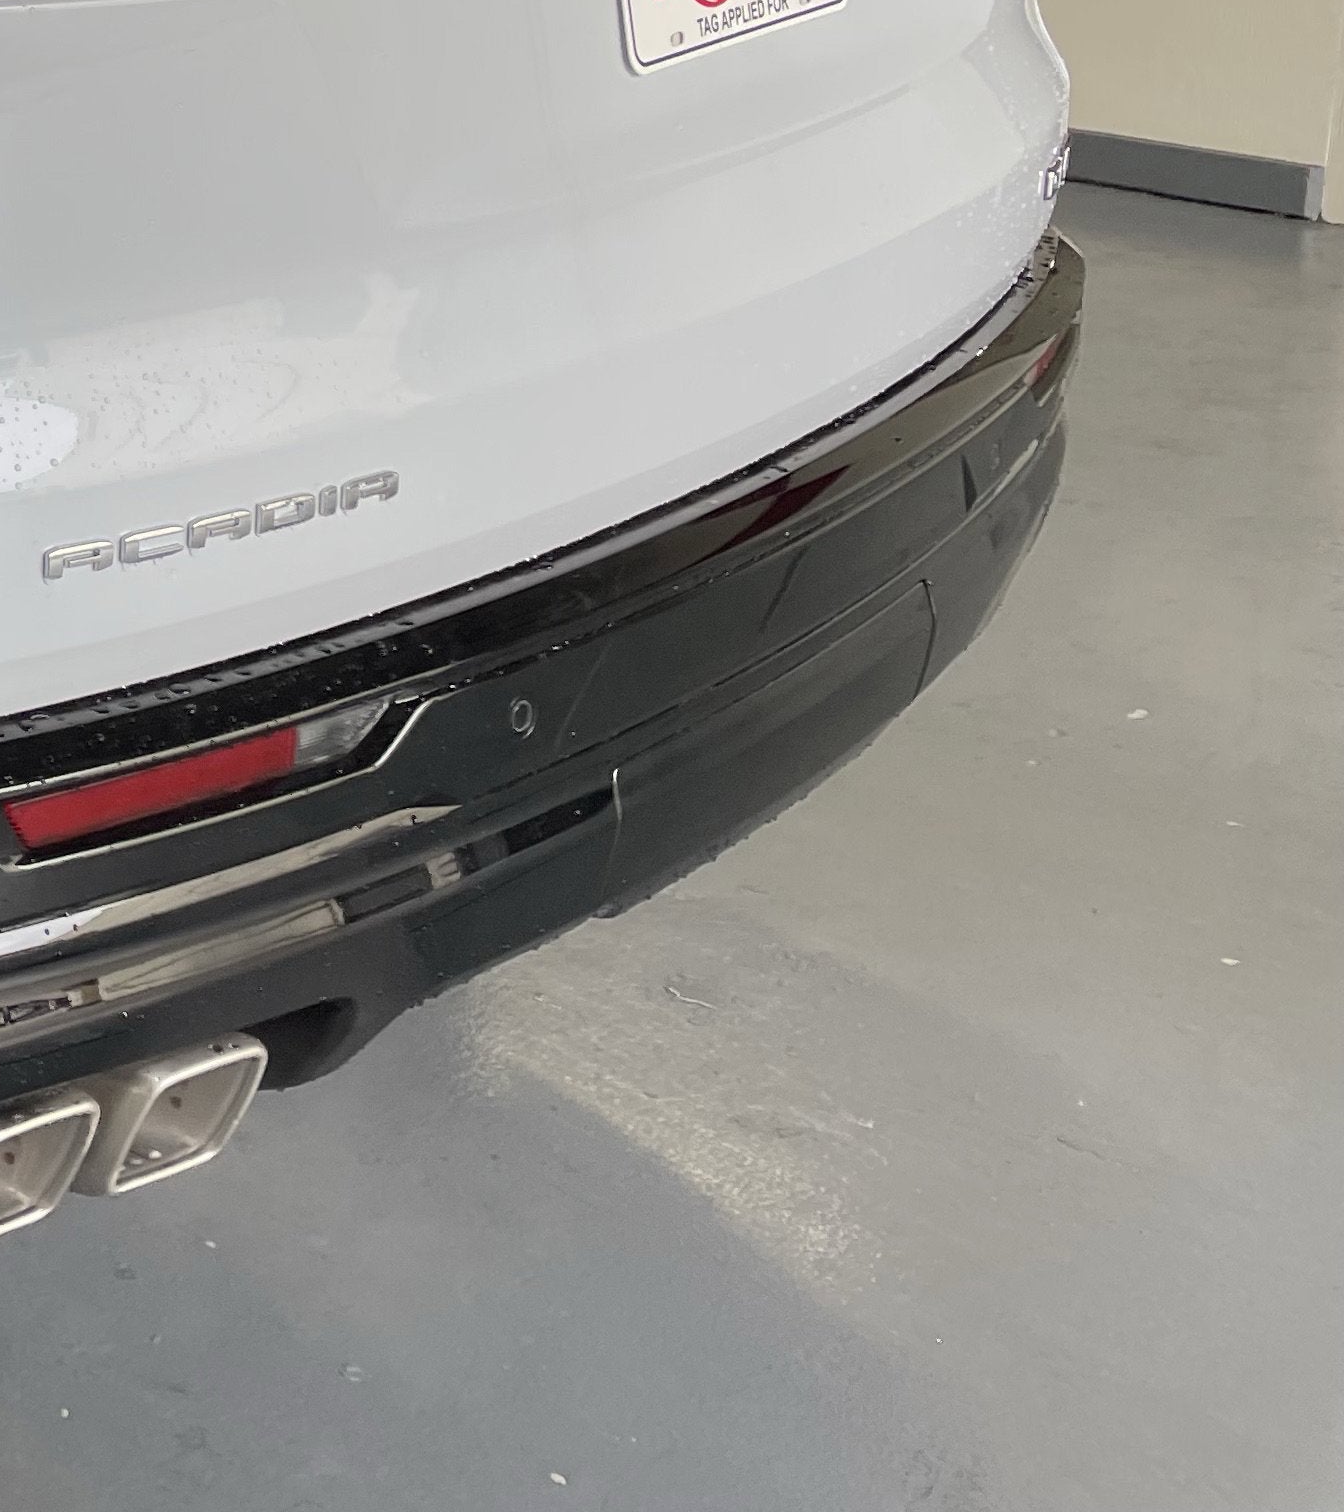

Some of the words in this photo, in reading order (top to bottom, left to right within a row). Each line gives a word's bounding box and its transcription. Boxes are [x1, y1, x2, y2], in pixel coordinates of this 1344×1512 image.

[696, 14, 720, 37] TAG
[721, 0, 766, 30] APPLIED
[42, 470, 400, 581] ACADIA
